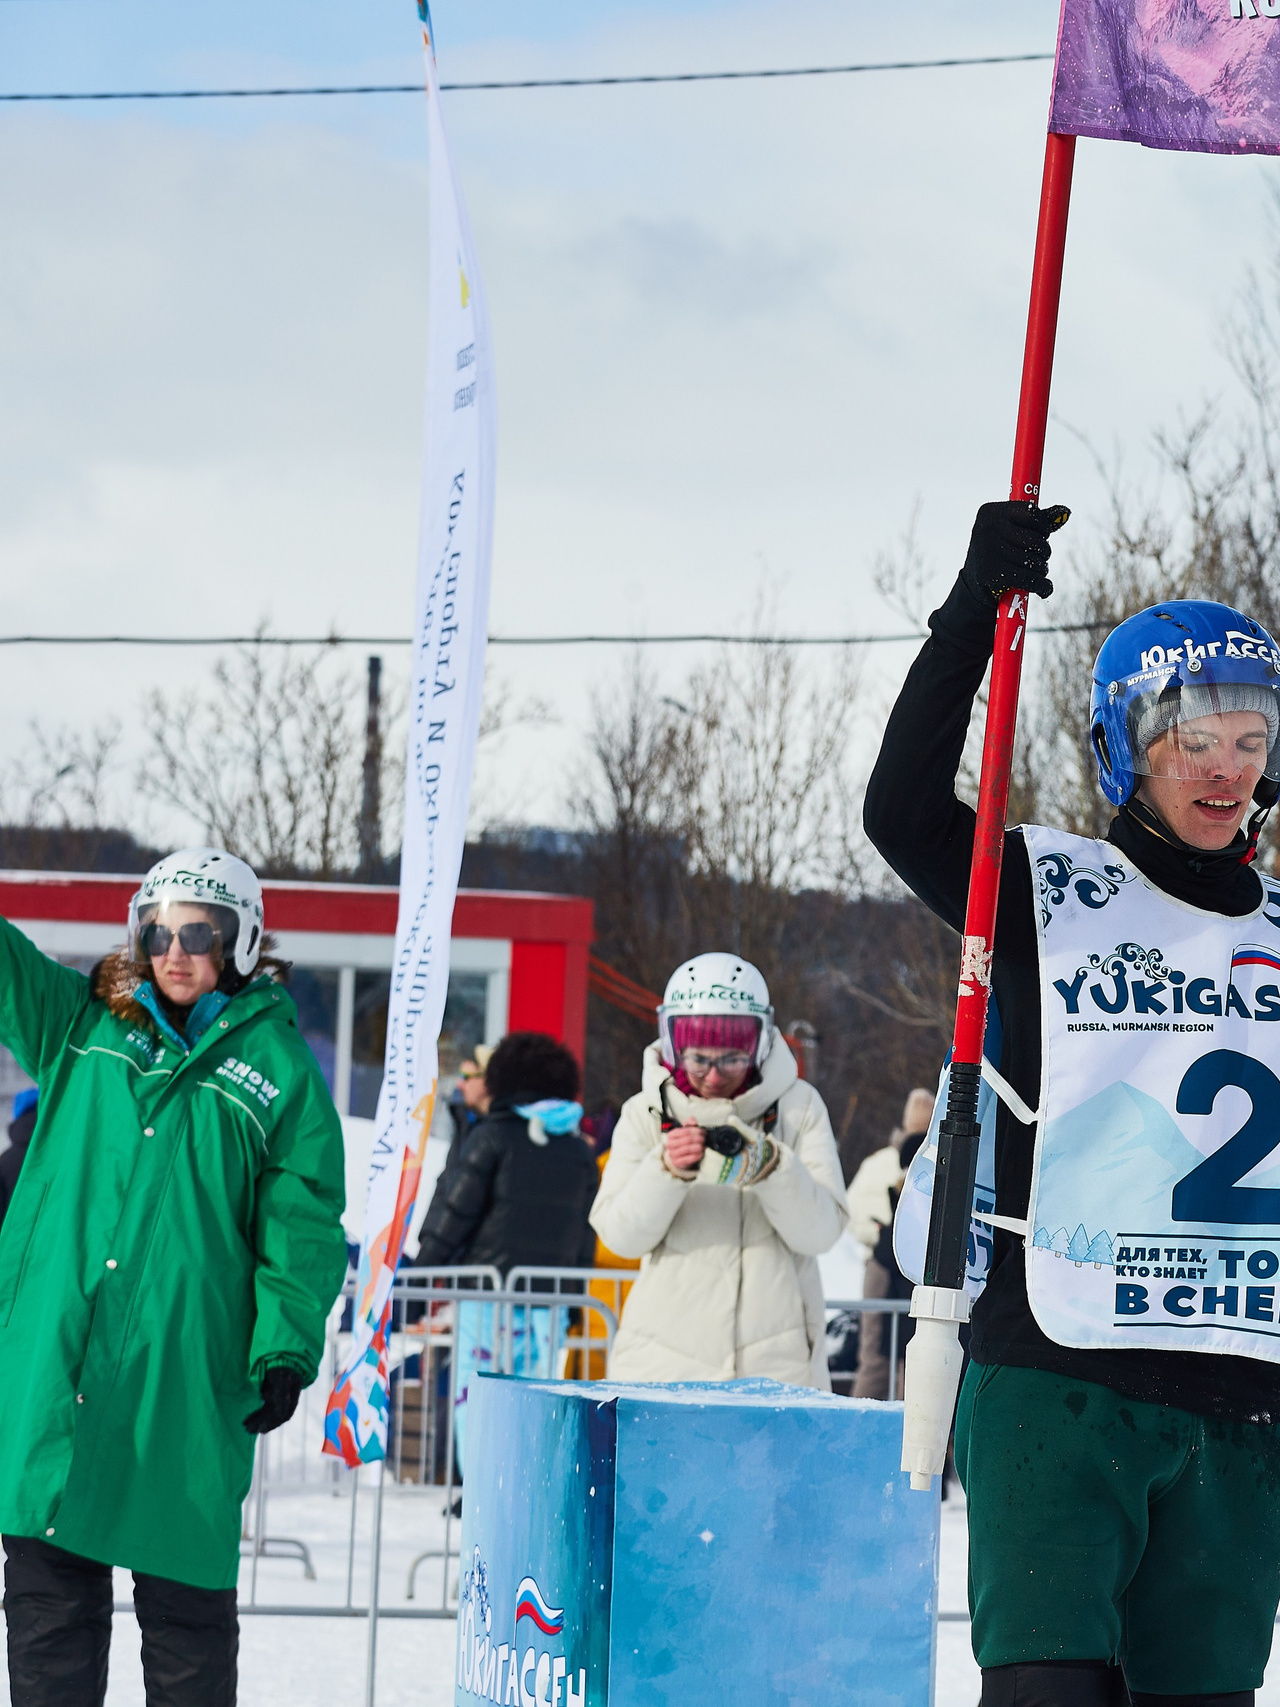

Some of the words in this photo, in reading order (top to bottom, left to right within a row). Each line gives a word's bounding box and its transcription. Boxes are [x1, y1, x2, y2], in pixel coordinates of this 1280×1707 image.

[1127, 666, 1177, 687] МУРМАНСК
[1067, 1022, 1110, 1032] RUSSIA,
[1112, 1022, 1170, 1032] MURMANSK
[1172, 1023, 1214, 1033] REGION
[223, 1057, 280, 1100] SNOW
[1116, 1246, 1160, 1263] ДЛЯ
[1163, 1248, 1208, 1265] ТЕХ,
[1115, 1264, 1150, 1278] КТО
[1152, 1266, 1208, 1280] ЗНАЕТ
[1114, 1282, 1150, 1316] В
